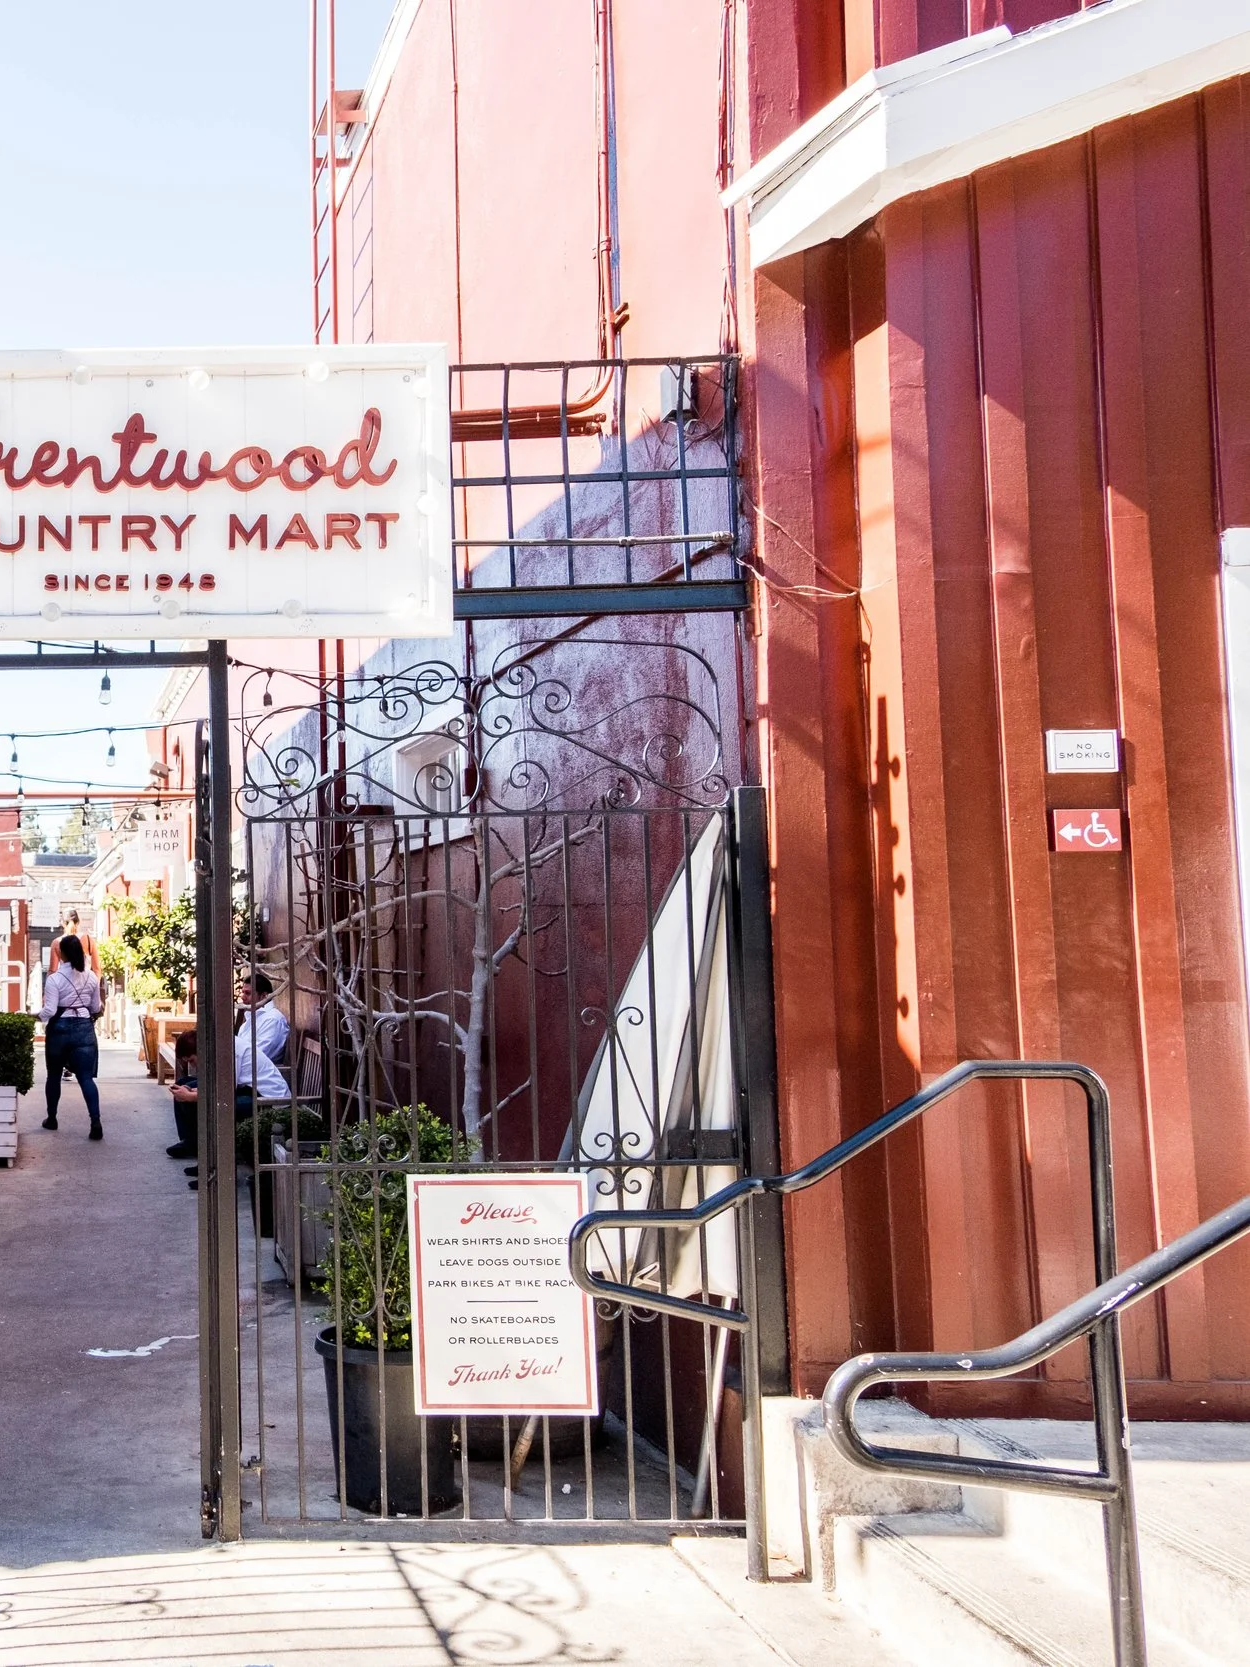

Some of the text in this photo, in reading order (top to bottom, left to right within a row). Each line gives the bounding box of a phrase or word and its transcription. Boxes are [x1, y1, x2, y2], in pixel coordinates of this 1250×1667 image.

[228, 512, 400, 551] MART
[43, 573, 217, 592] SINCE 1948
[1059, 751, 1111, 759] SMOKING
[145, 829, 180, 839] FARM
[460, 1201, 537, 1224] Please
[427, 1238, 459, 1246] WEAR
[462, 1237, 503, 1246] SHIRTS
[505, 1237, 531, 1245] AND
[439, 1258, 562, 1267] LEAVE DOGS OUTSIDE
[428, 1279, 575, 1288] PARK BIKES AT BIKE RACK
[450, 1316, 556, 1325] NO SKATEBOARDS
[448, 1336, 559, 1345] OR ROLLERBLADES
[447, 1356, 564, 1387] Thank You!
